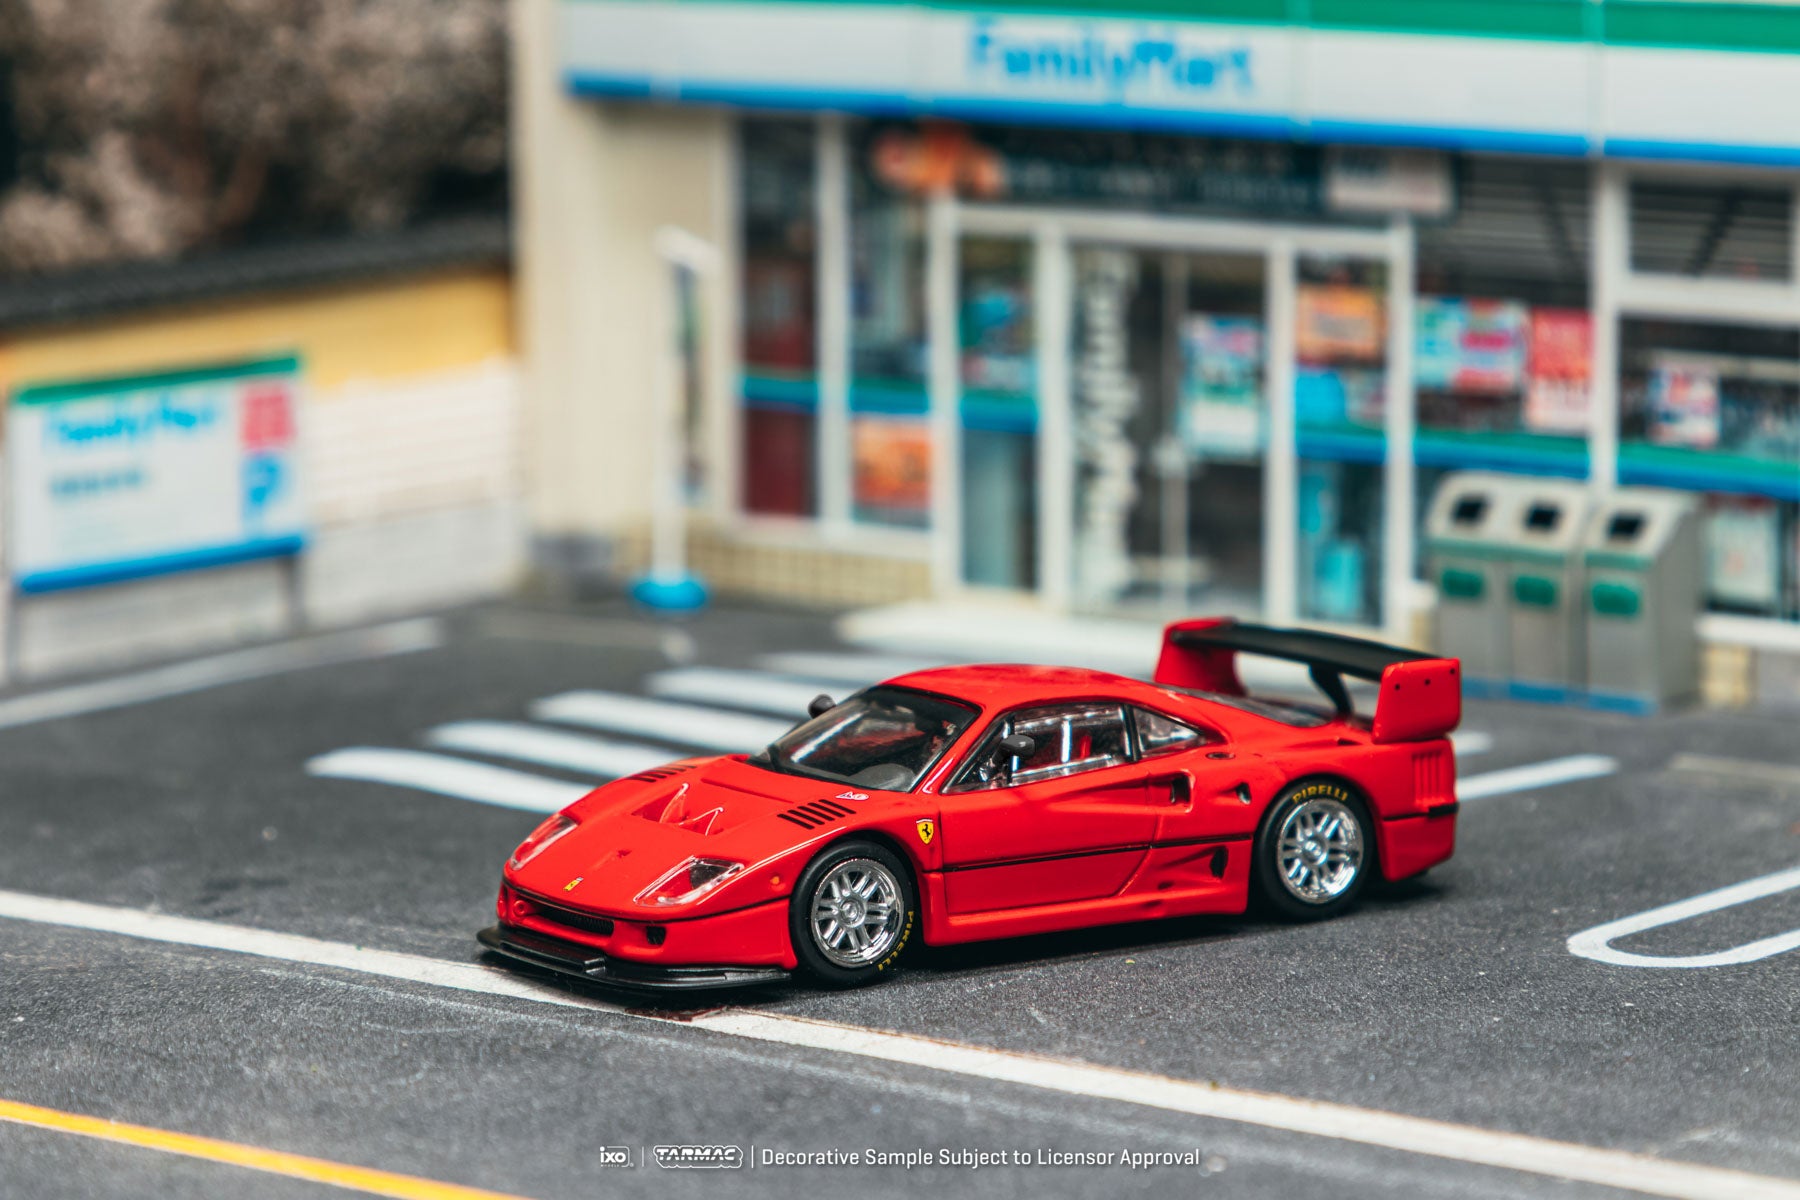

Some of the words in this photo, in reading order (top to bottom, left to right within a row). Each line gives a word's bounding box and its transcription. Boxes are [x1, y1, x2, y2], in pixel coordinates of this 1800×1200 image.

[968, 14, 1253, 103] FamilyMart
[1292, 784, 1349, 804] PIRELLI
[877, 911, 914, 971] PIRELLI
